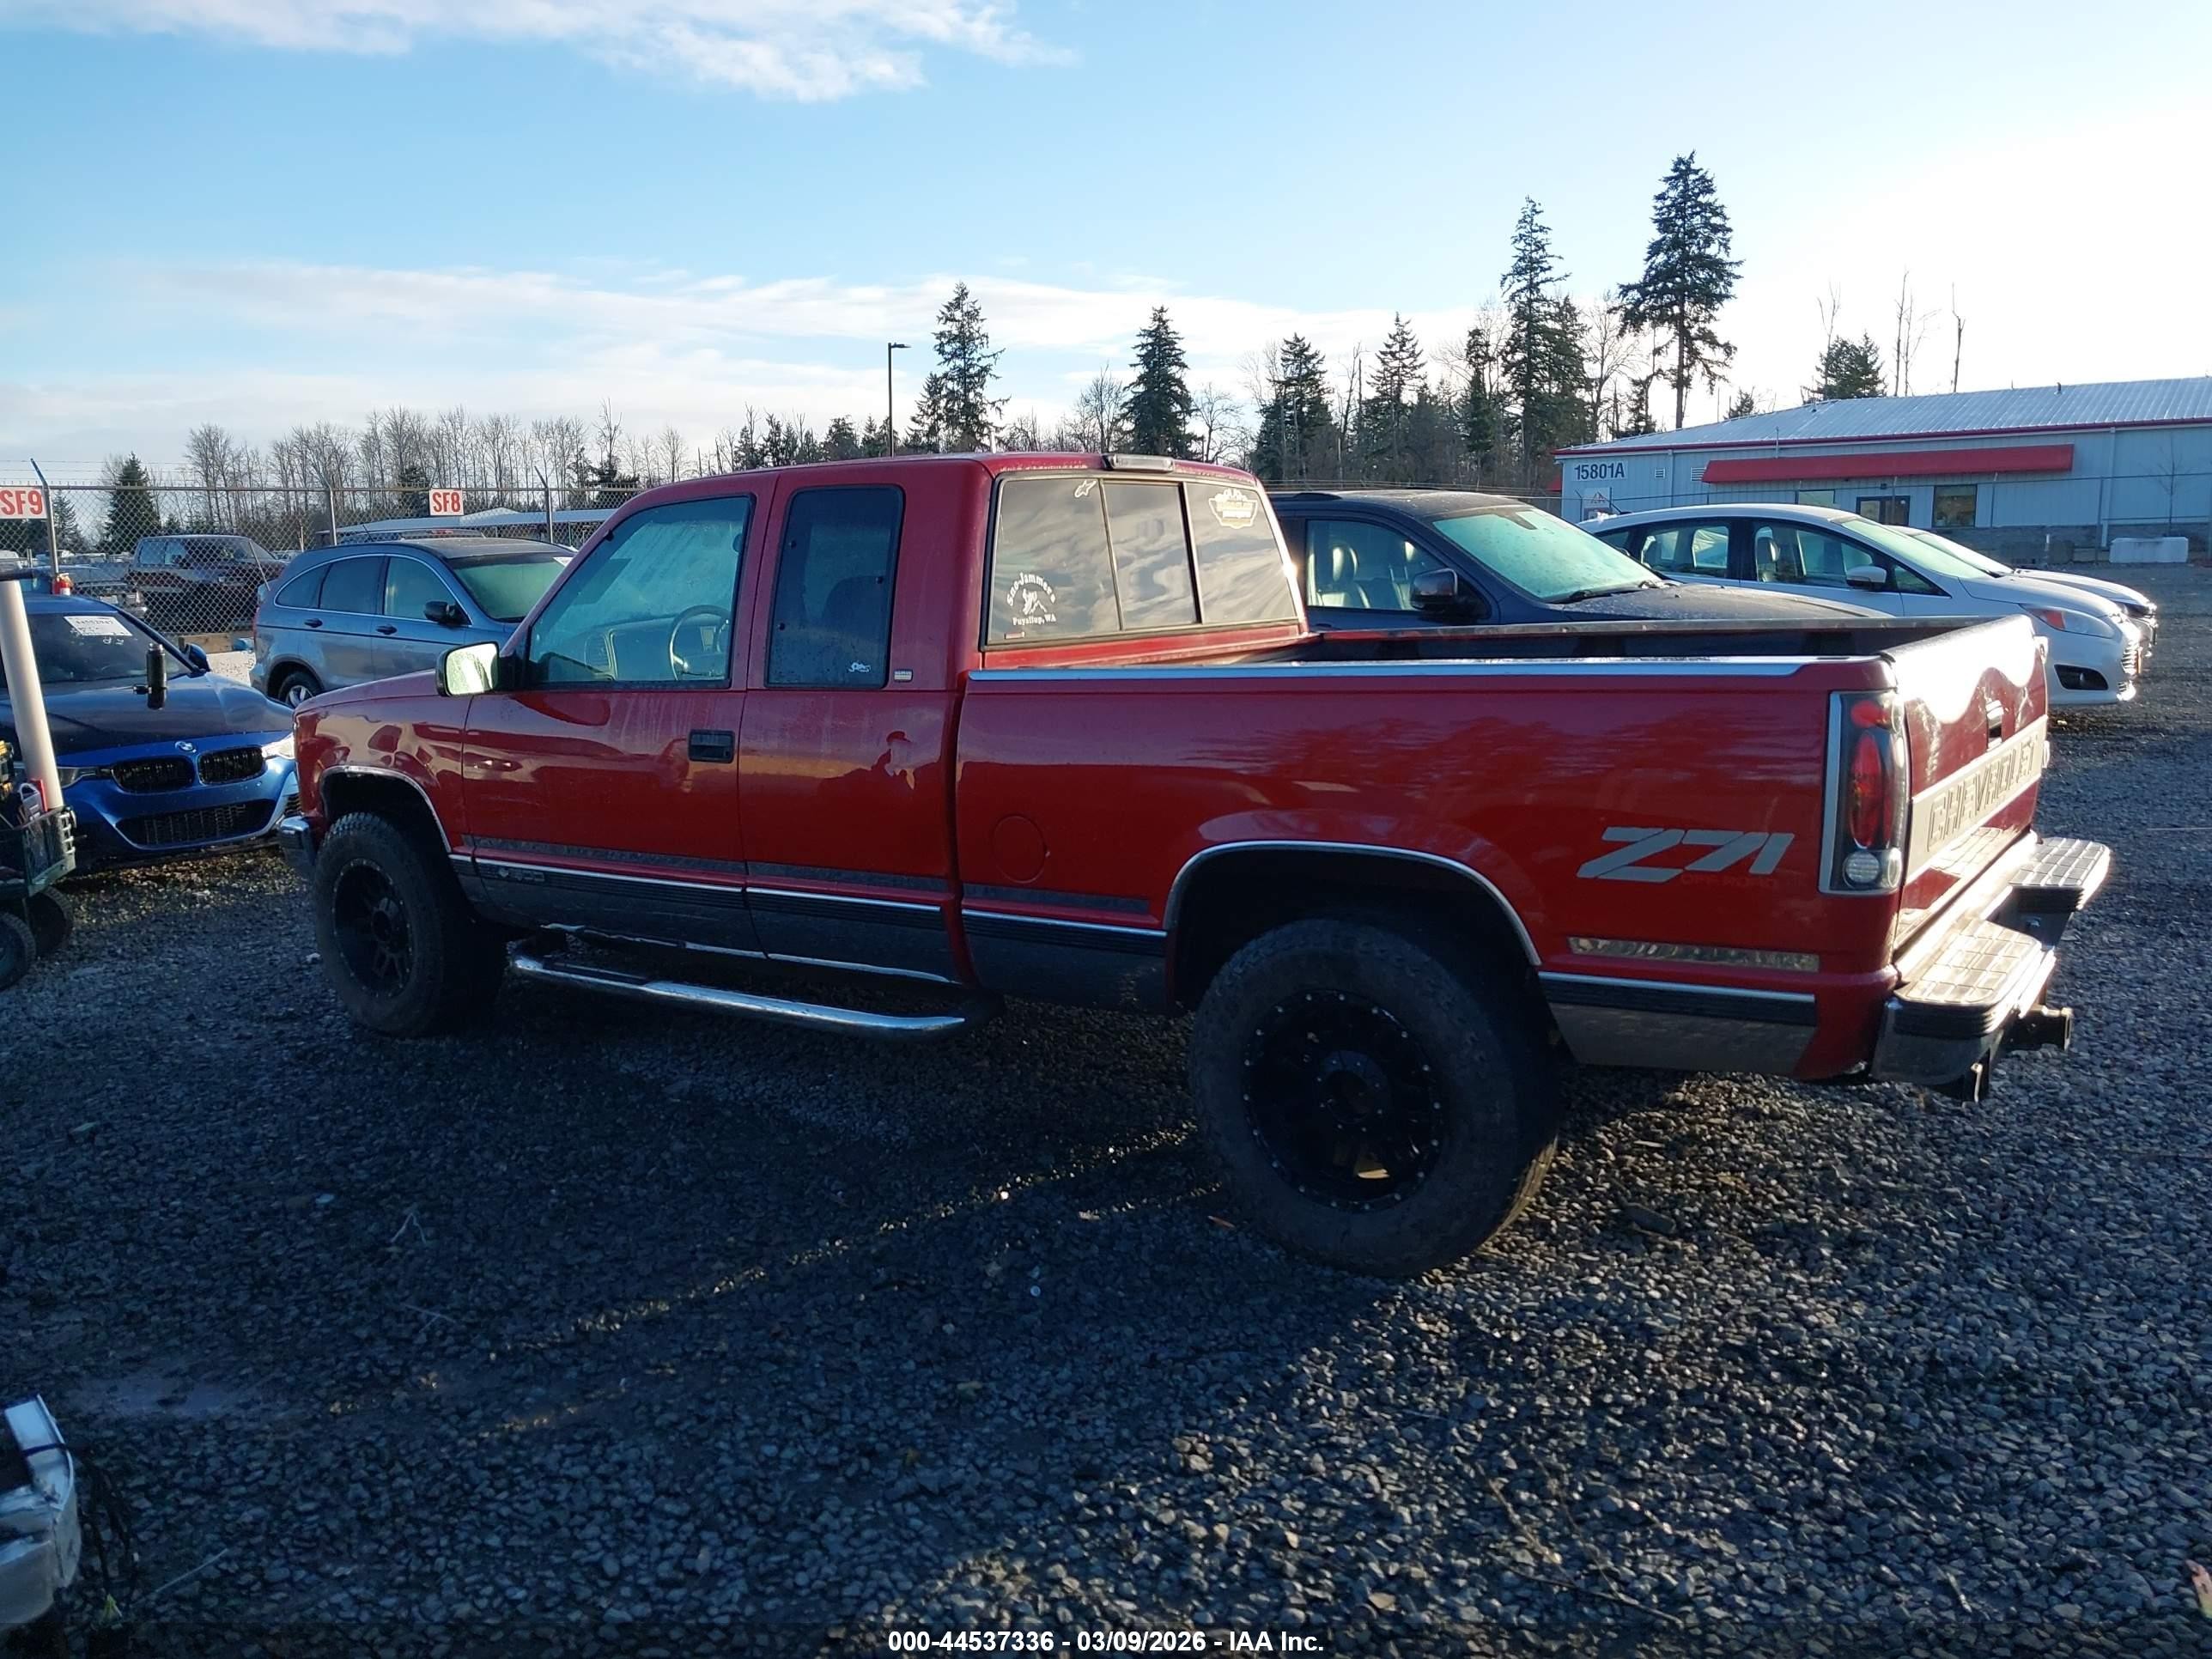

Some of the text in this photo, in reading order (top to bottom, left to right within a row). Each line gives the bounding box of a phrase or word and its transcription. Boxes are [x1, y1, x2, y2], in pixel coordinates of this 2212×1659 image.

[1574, 462, 1625, 481] 15801A
[0, 489, 43, 515] SF9
[432, 491, 461, 513] SF8
[1927, 734, 2039, 852] CHEVROLET
[1577, 826, 1796, 884] Z71
